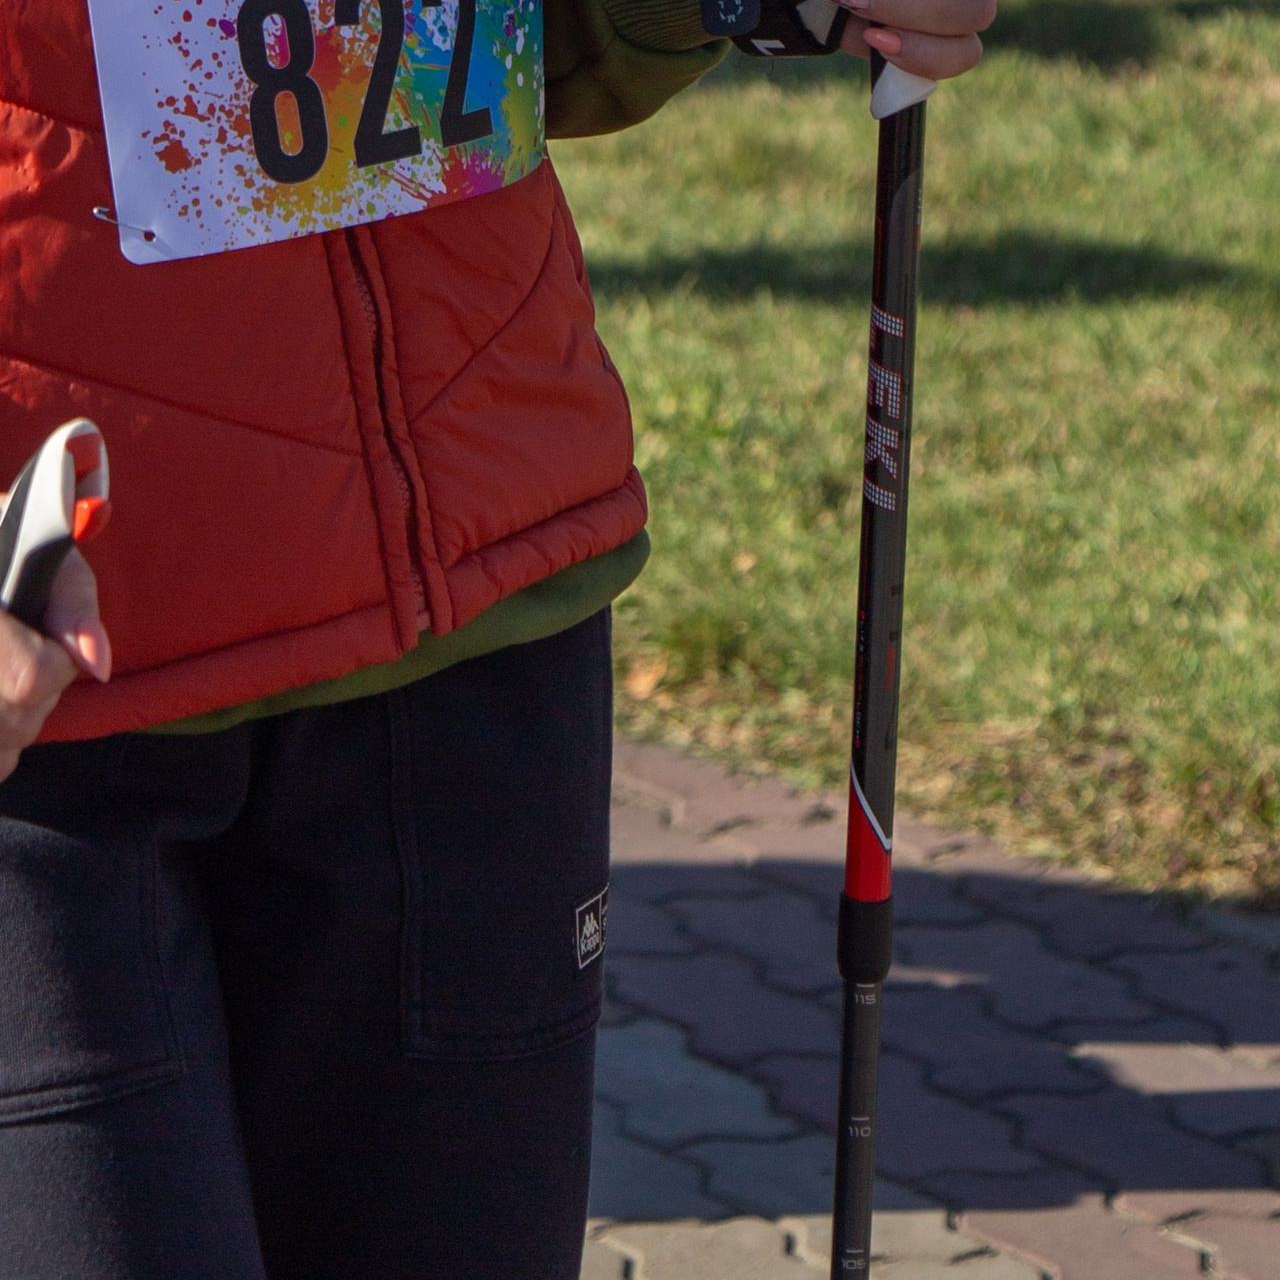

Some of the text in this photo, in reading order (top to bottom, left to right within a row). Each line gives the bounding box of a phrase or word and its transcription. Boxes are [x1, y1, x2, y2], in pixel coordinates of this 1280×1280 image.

[580, 933, 601, 956] Kappa
[853, 993, 877, 1005] 115
[848, 1125, 872, 1138] 110
[841, 1259, 867, 1270] 105
